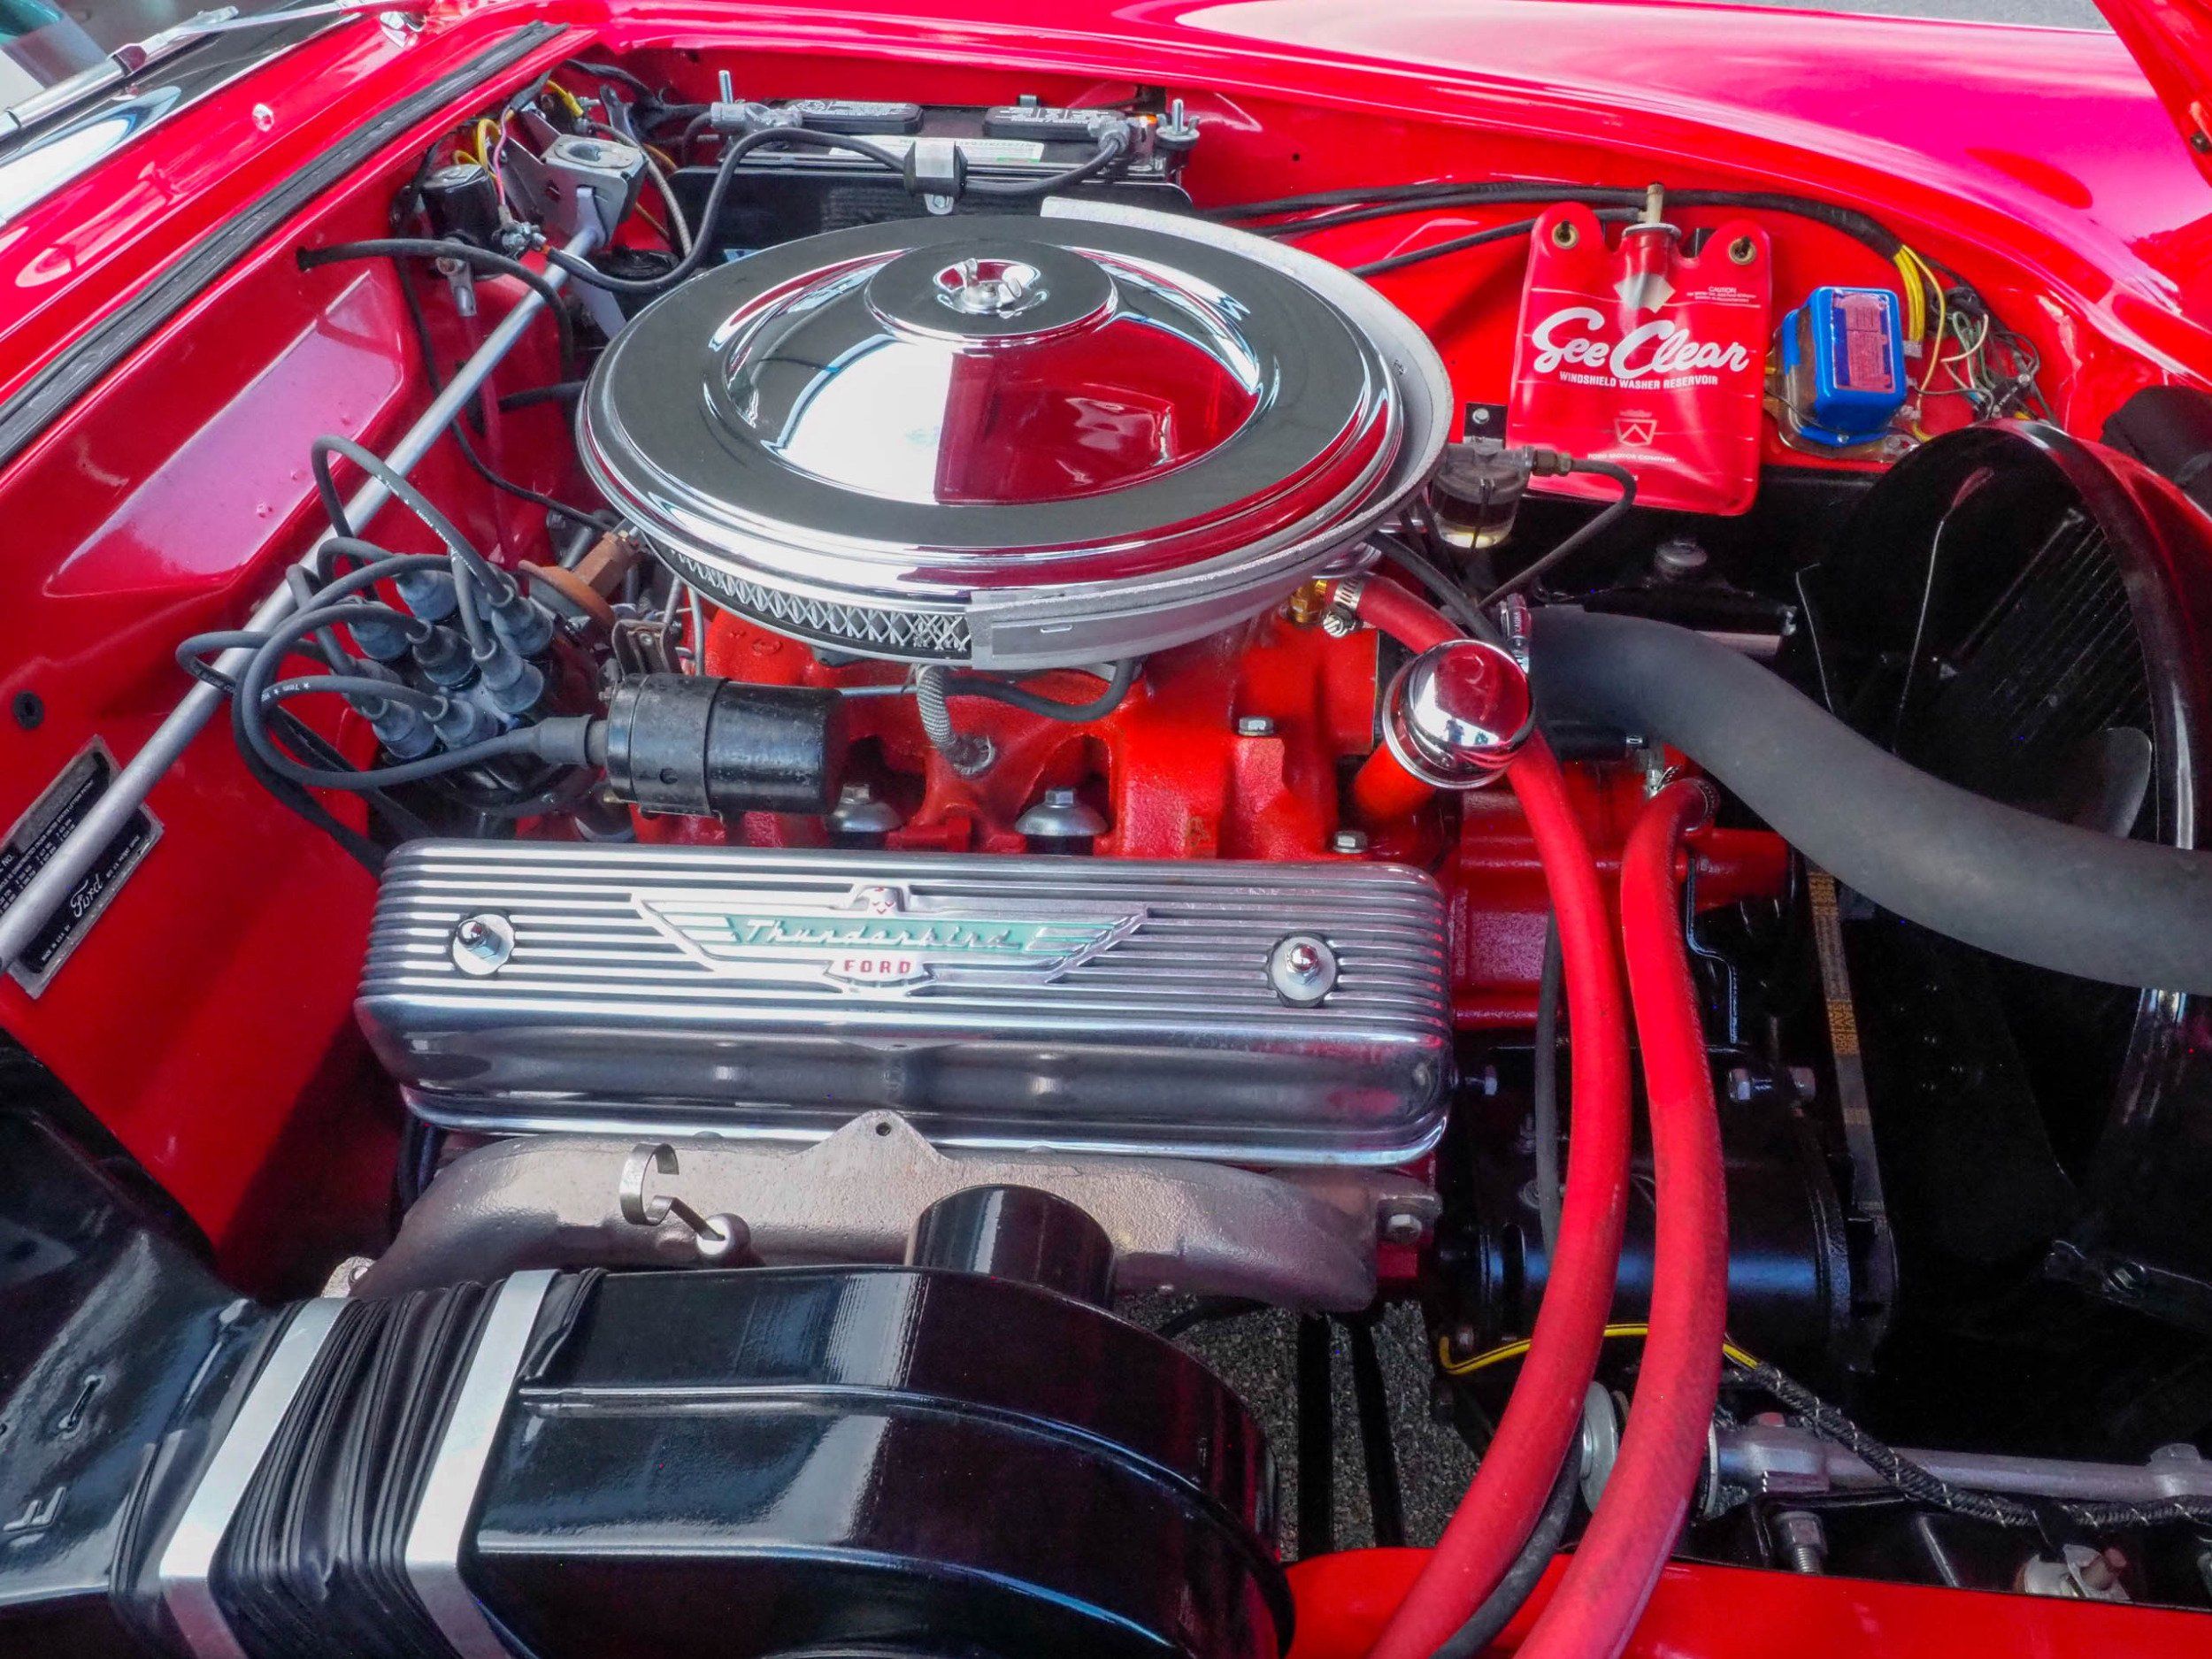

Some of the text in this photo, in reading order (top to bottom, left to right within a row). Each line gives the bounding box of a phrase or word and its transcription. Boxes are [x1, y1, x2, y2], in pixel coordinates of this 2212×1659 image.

[1532, 307, 1749, 379] See Clear
[1559, 371, 1718, 390] WINDSHIELD WASHER RESERVOIR
[1638, 454, 1676, 464] COMPANY
[70, 875, 104, 918] Ford
[745, 918, 1022, 949] Thunderbird
[842, 959, 912, 975] FORD
